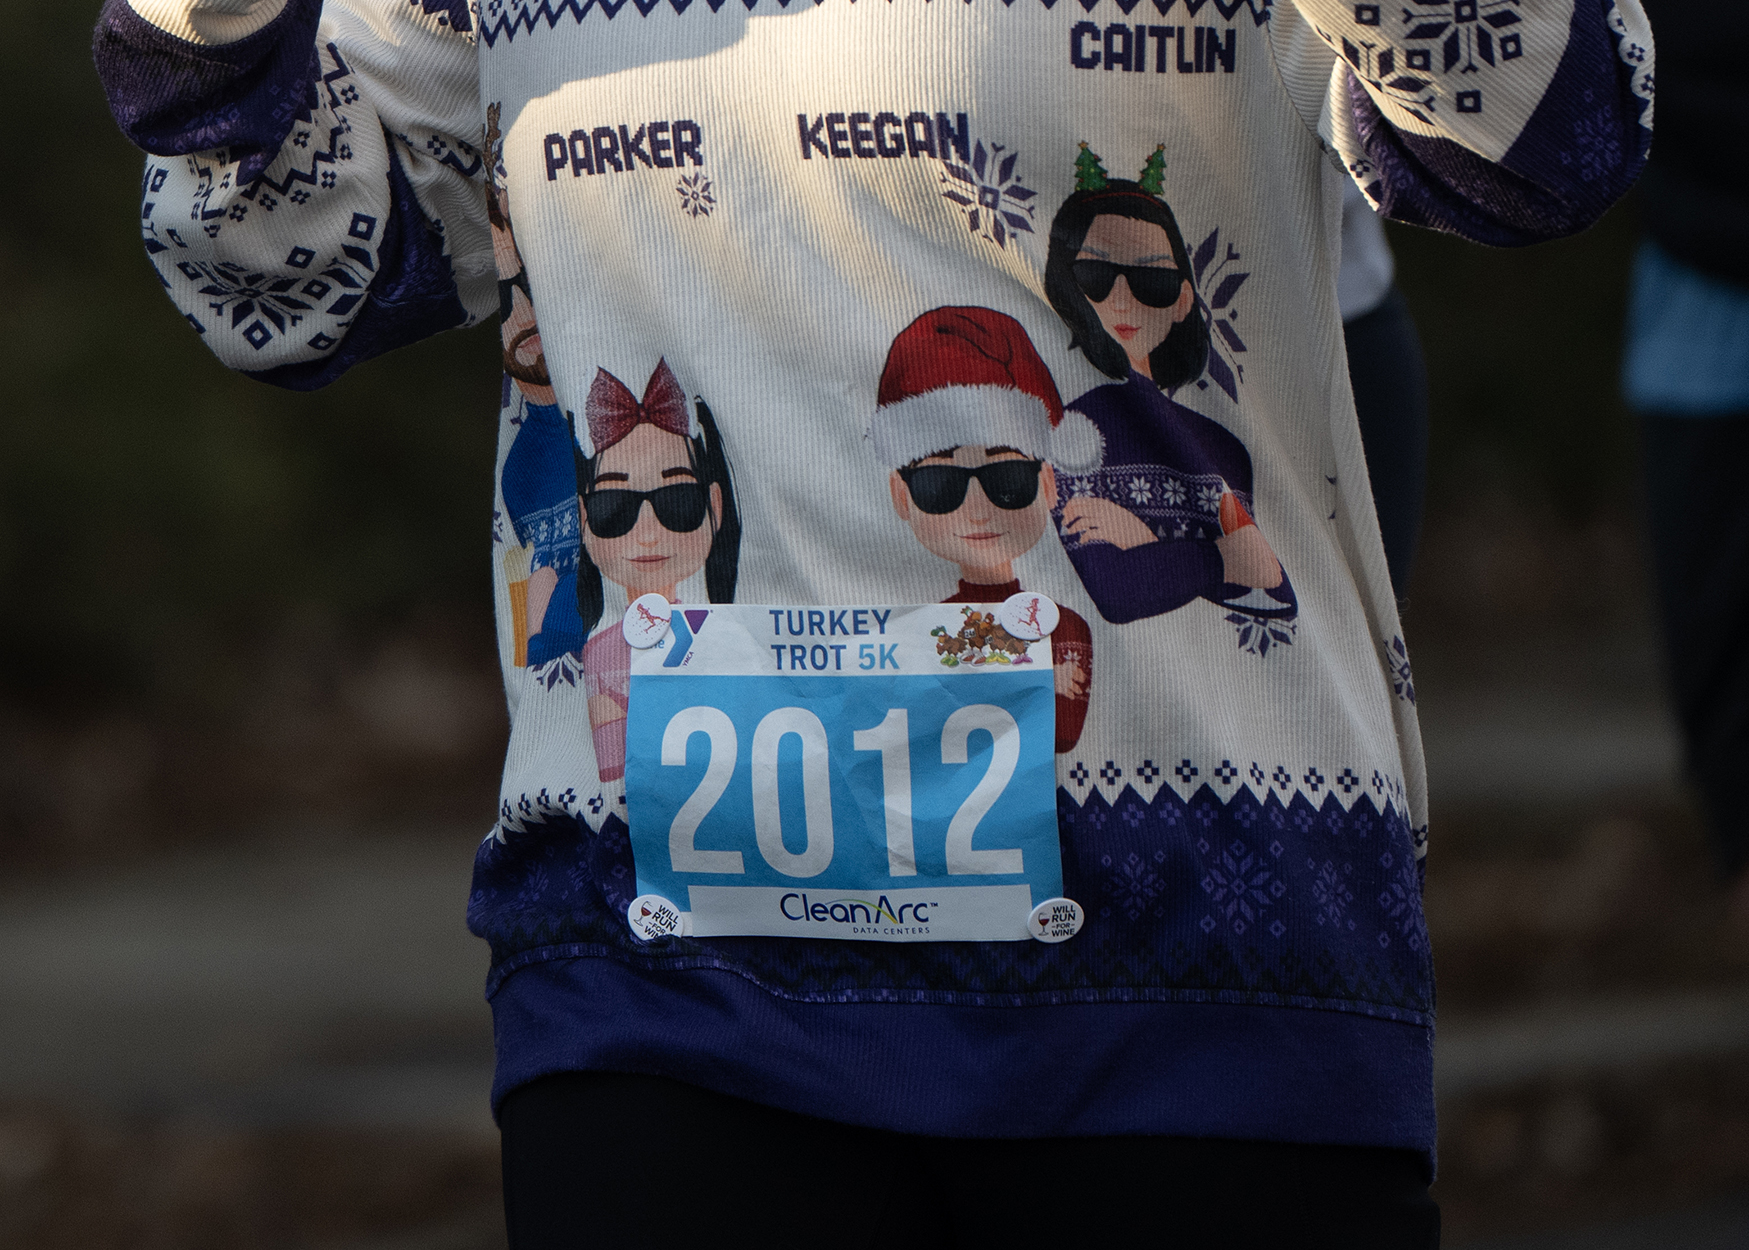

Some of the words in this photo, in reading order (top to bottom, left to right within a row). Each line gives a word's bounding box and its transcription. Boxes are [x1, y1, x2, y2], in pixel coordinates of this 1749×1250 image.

[1070, 20, 1237, 74] CAITLIN
[797, 111, 971, 166] KEEGAN
[543, 118, 704, 182] PARKER
[769, 608, 892, 637] TURKEY
[682, 650, 695, 667] YMCA
[770, 643, 847, 671] TROT
[858, 642, 901, 671] 5K
[660, 703, 1025, 879] 2012
[658, 904, 679, 925] WILL
[1051, 912, 1076, 923] RUN
[1052, 904, 1076, 914] WILL
[651, 911, 677, 932] RUN
[853, 926, 879, 935] DATA
[883, 926, 930, 936] CENTERS
[1051, 928, 1075, 937] WINE
